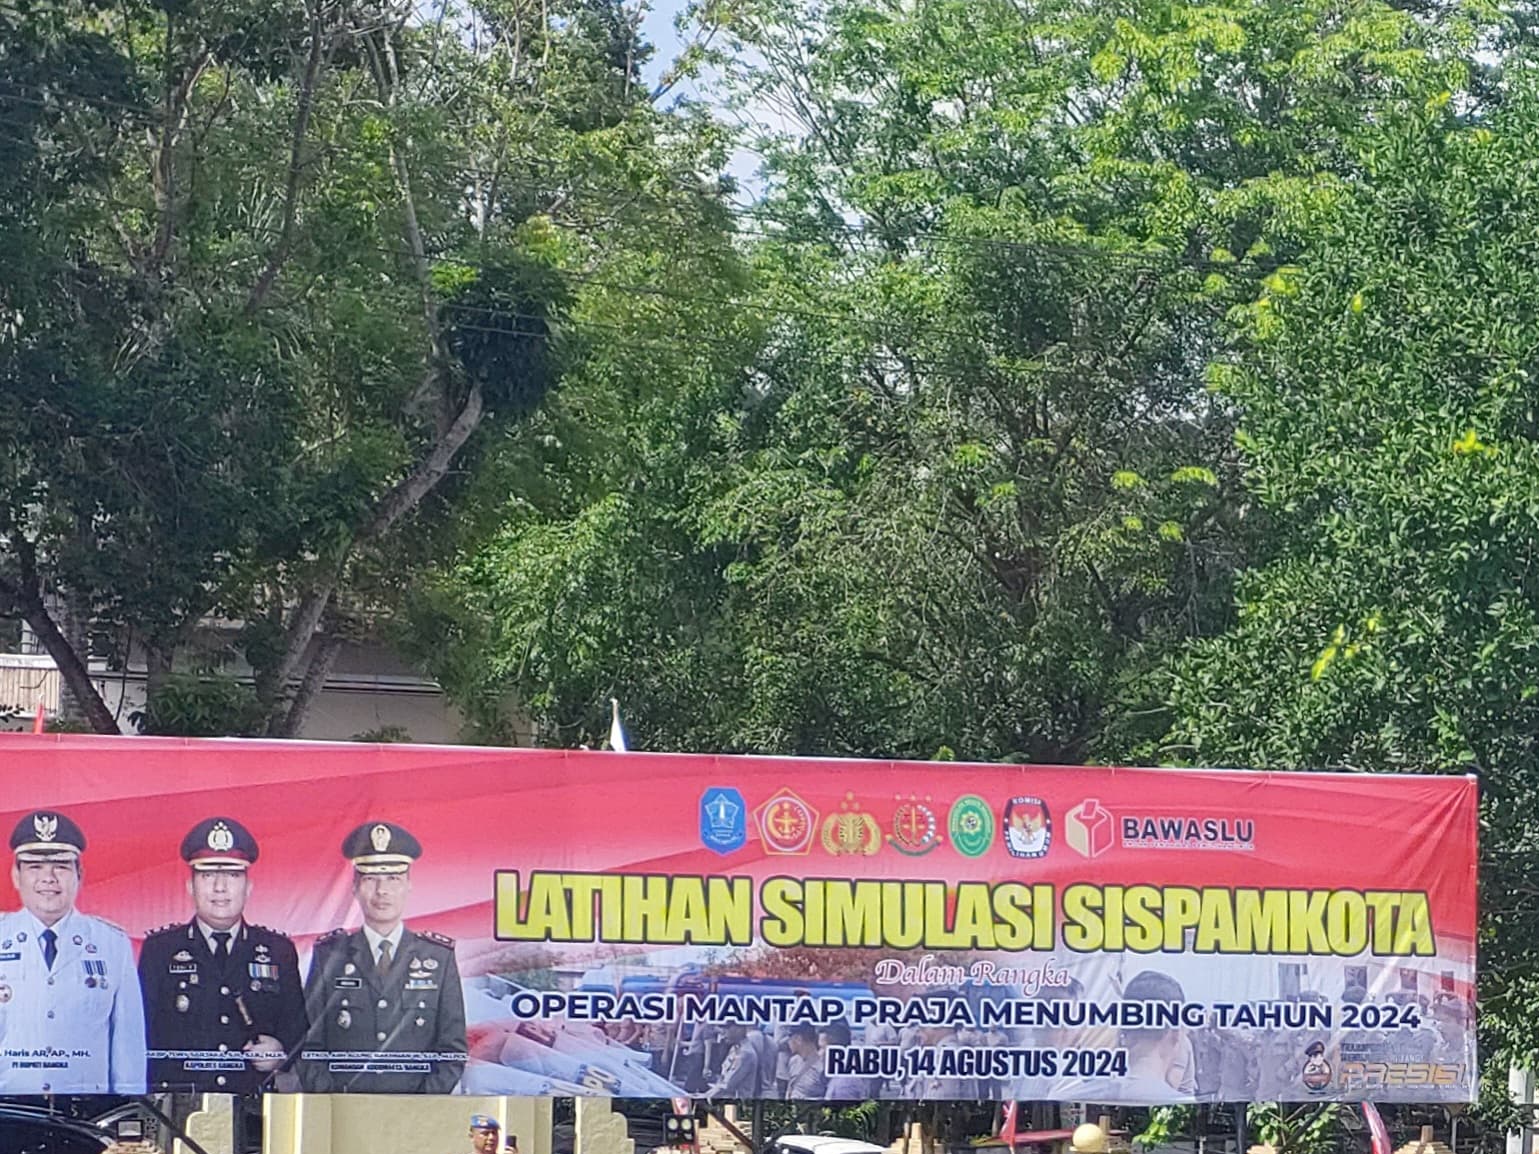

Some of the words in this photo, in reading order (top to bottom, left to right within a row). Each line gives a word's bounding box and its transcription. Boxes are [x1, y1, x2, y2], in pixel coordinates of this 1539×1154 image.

[1123, 818, 1253, 842] BAWASLU
[494, 870, 753, 946] LATIHAN
[760, 877, 1056, 951] SIMULASI
[1062, 884, 1436, 957] SISPAMKOTA
[875, 956, 965, 986] Dalam
[968, 958, 1070, 995] Rangka
[511, 993, 674, 1021] OPERASI
[686, 996, 844, 1025] MANTAP
[854, 998, 973, 1026] PRAJA
[981, 1000, 1204, 1028] MENUMBING
[1214, 1003, 1332, 1028] TAHUN
[1341, 1004, 1420, 1029] 2024
[827, 1048, 905, 1079] RABU,
[907, 1048, 936, 1076] 14
[937, 1048, 1058, 1077] AGUSTUS
[1062, 1049, 1127, 1077] 2024
